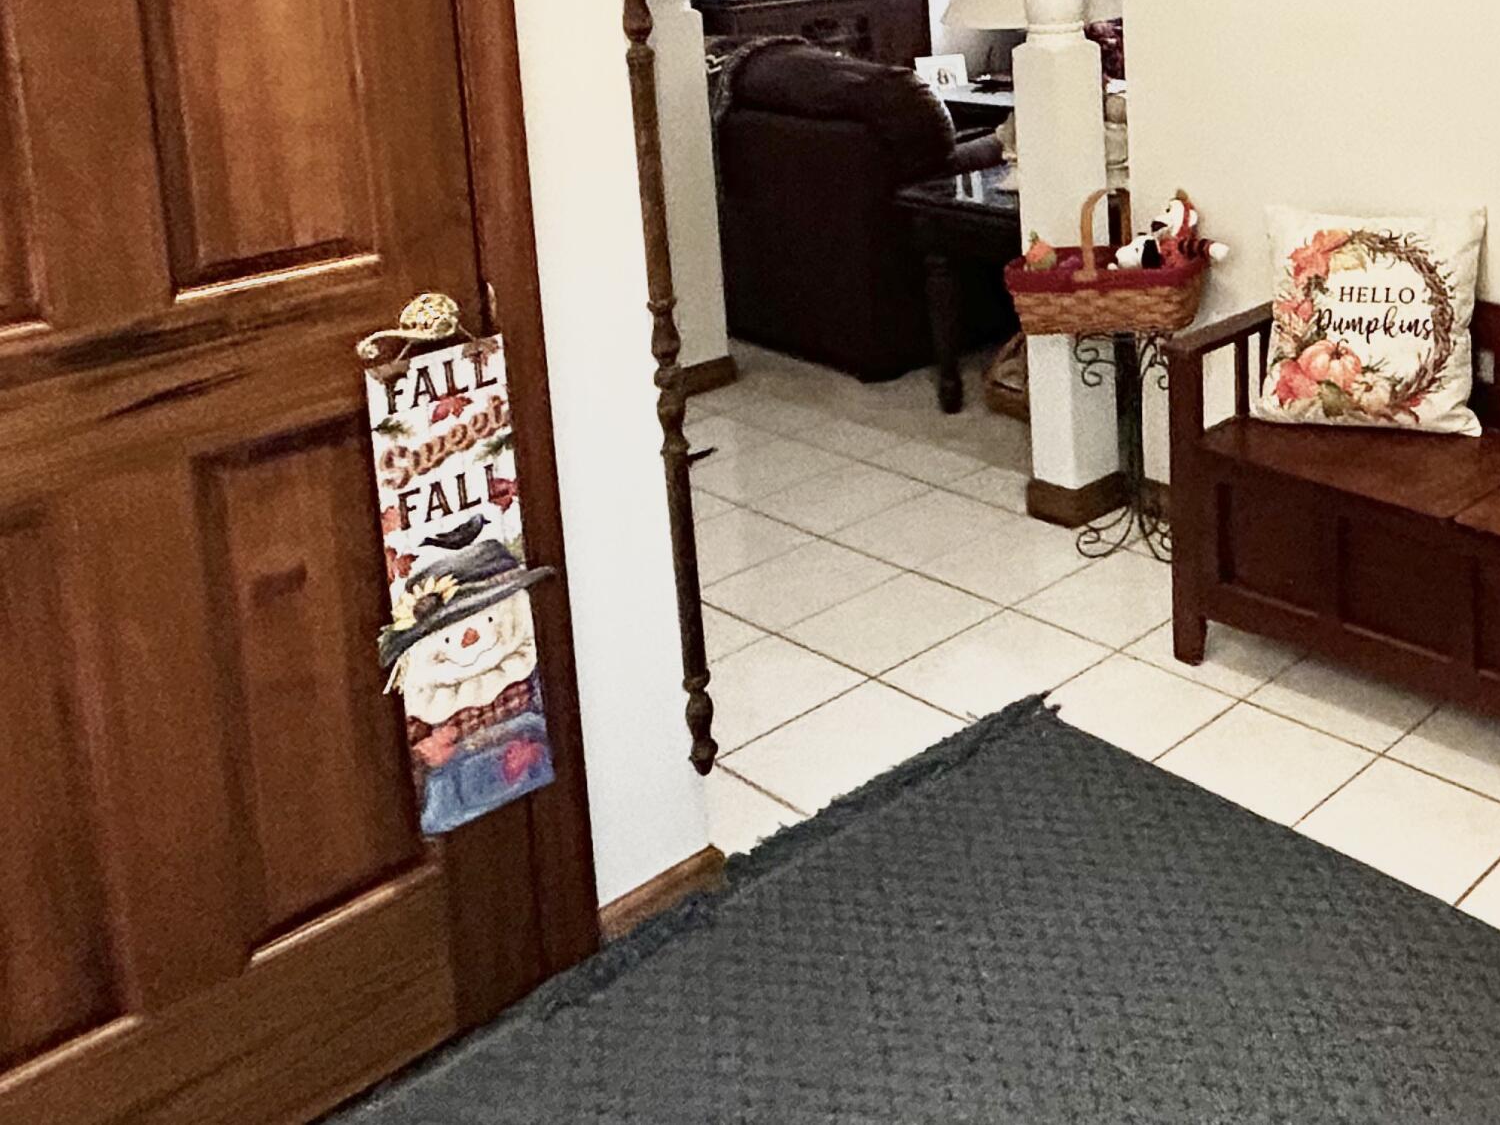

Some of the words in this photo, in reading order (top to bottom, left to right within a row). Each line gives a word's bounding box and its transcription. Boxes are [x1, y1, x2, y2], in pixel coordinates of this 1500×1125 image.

[1315, 305, 1434, 345] Pumpkins
[1338, 286, 1416, 305] HELLO
[384, 351, 498, 415] FALL
[380, 395, 512, 490] Sweet
[397, 463, 509, 531] FALL
